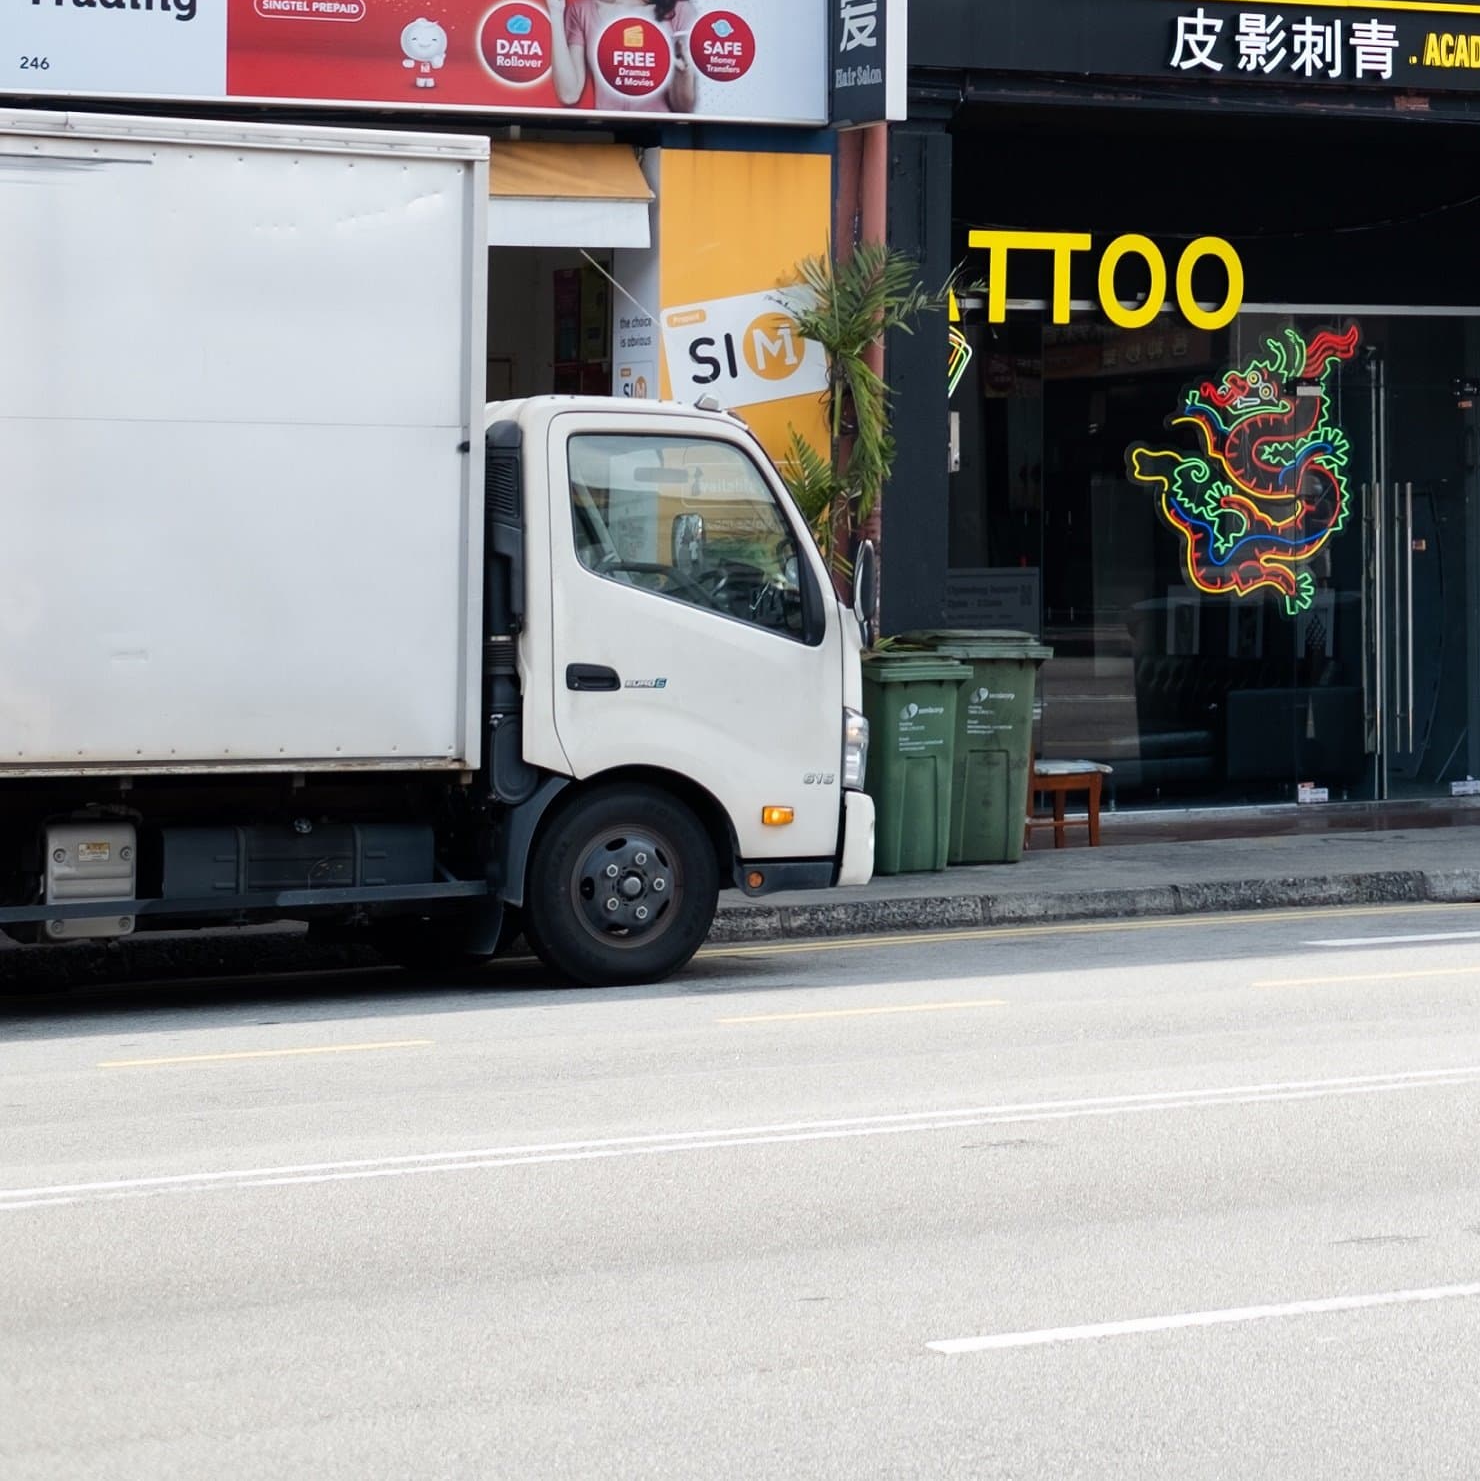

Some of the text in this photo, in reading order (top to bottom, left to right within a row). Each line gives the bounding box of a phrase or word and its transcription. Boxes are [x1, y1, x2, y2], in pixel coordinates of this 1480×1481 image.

[262, 0, 360, 15] SINGTEL PREPAID
[496, 39, 543, 56] DATA
[703, 40, 743, 56] SAFE
[1169, 7, 1400, 80] 皮影刺青
[19, 56, 51, 71] 246
[496, 56, 542, 69] Rollover
[613, 51, 656, 68] FREE
[710, 55, 737, 66] Money
[618, 67, 651, 77] Dramas
[706, 65, 741, 74] Transfers
[624, 77, 654, 87] Movies
[835, 67, 856, 89] Hair
[949, 229, 1244, 330] TTOO
